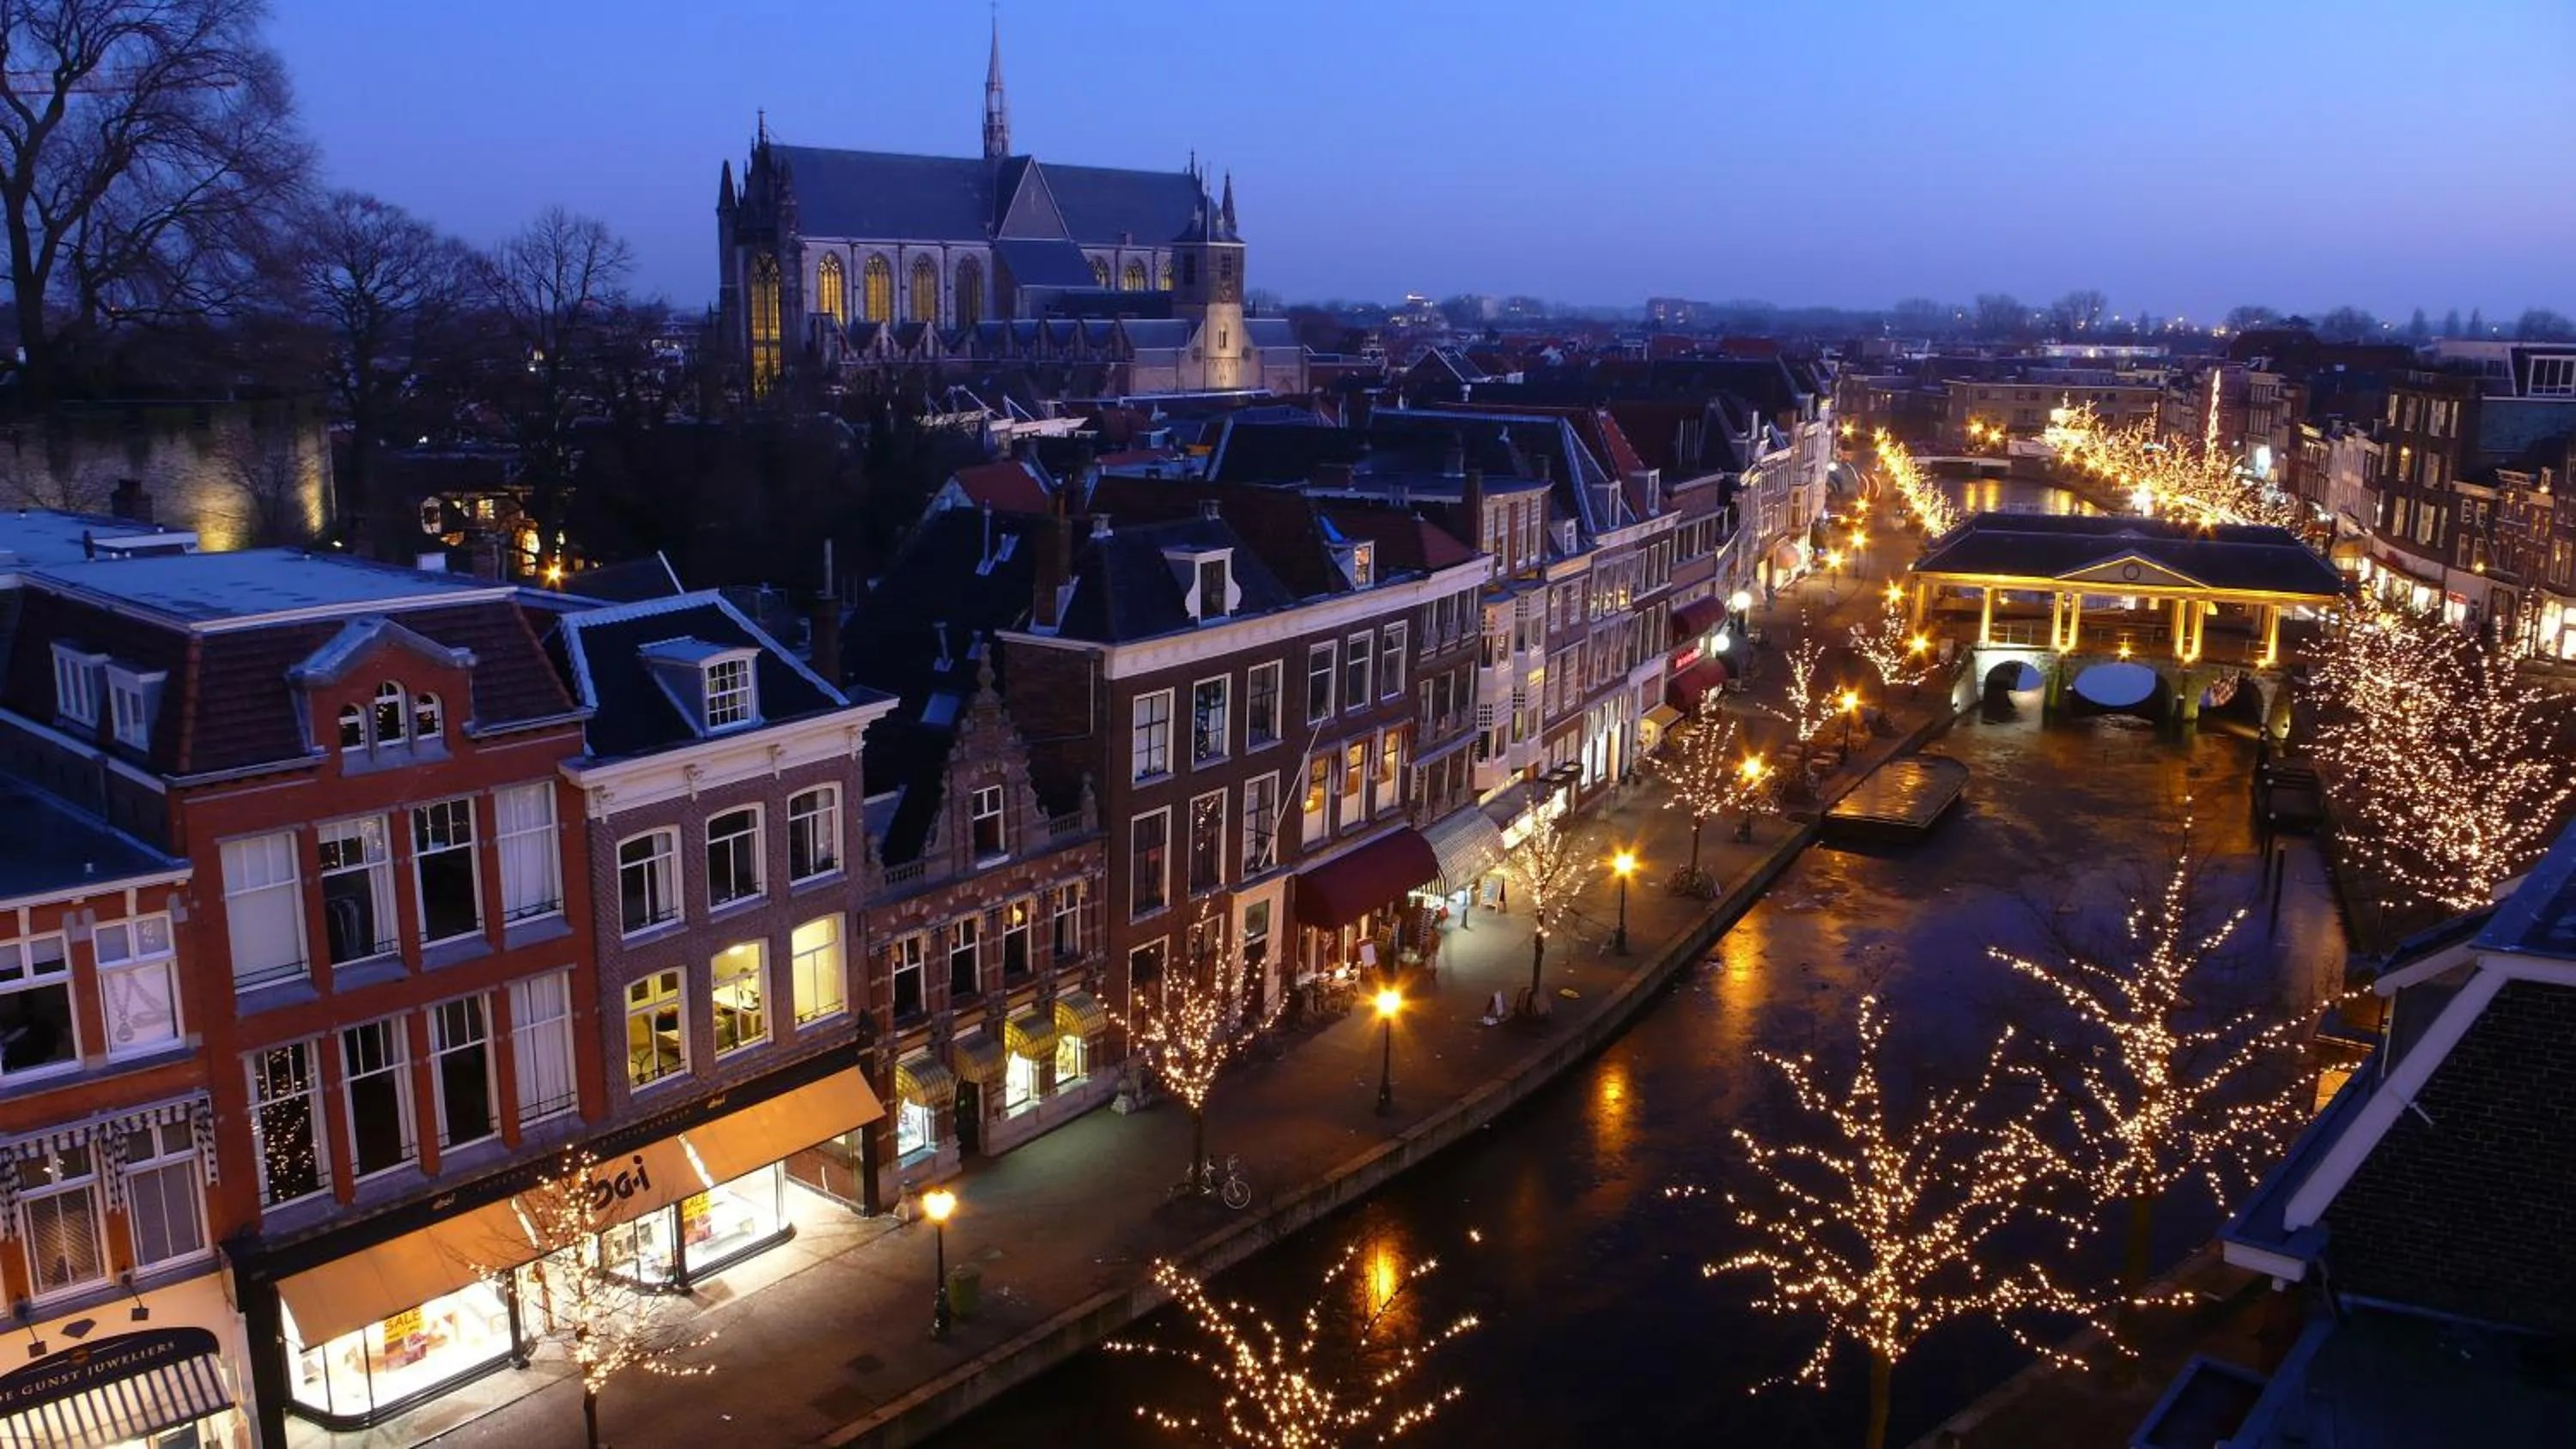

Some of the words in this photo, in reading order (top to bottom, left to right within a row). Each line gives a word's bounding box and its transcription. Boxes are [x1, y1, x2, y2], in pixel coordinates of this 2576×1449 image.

[384, 1307, 421, 1332] SALE
[21, 1370, 82, 1396] GUNST
[88, 1341, 175, 1377] JUWELIERS
